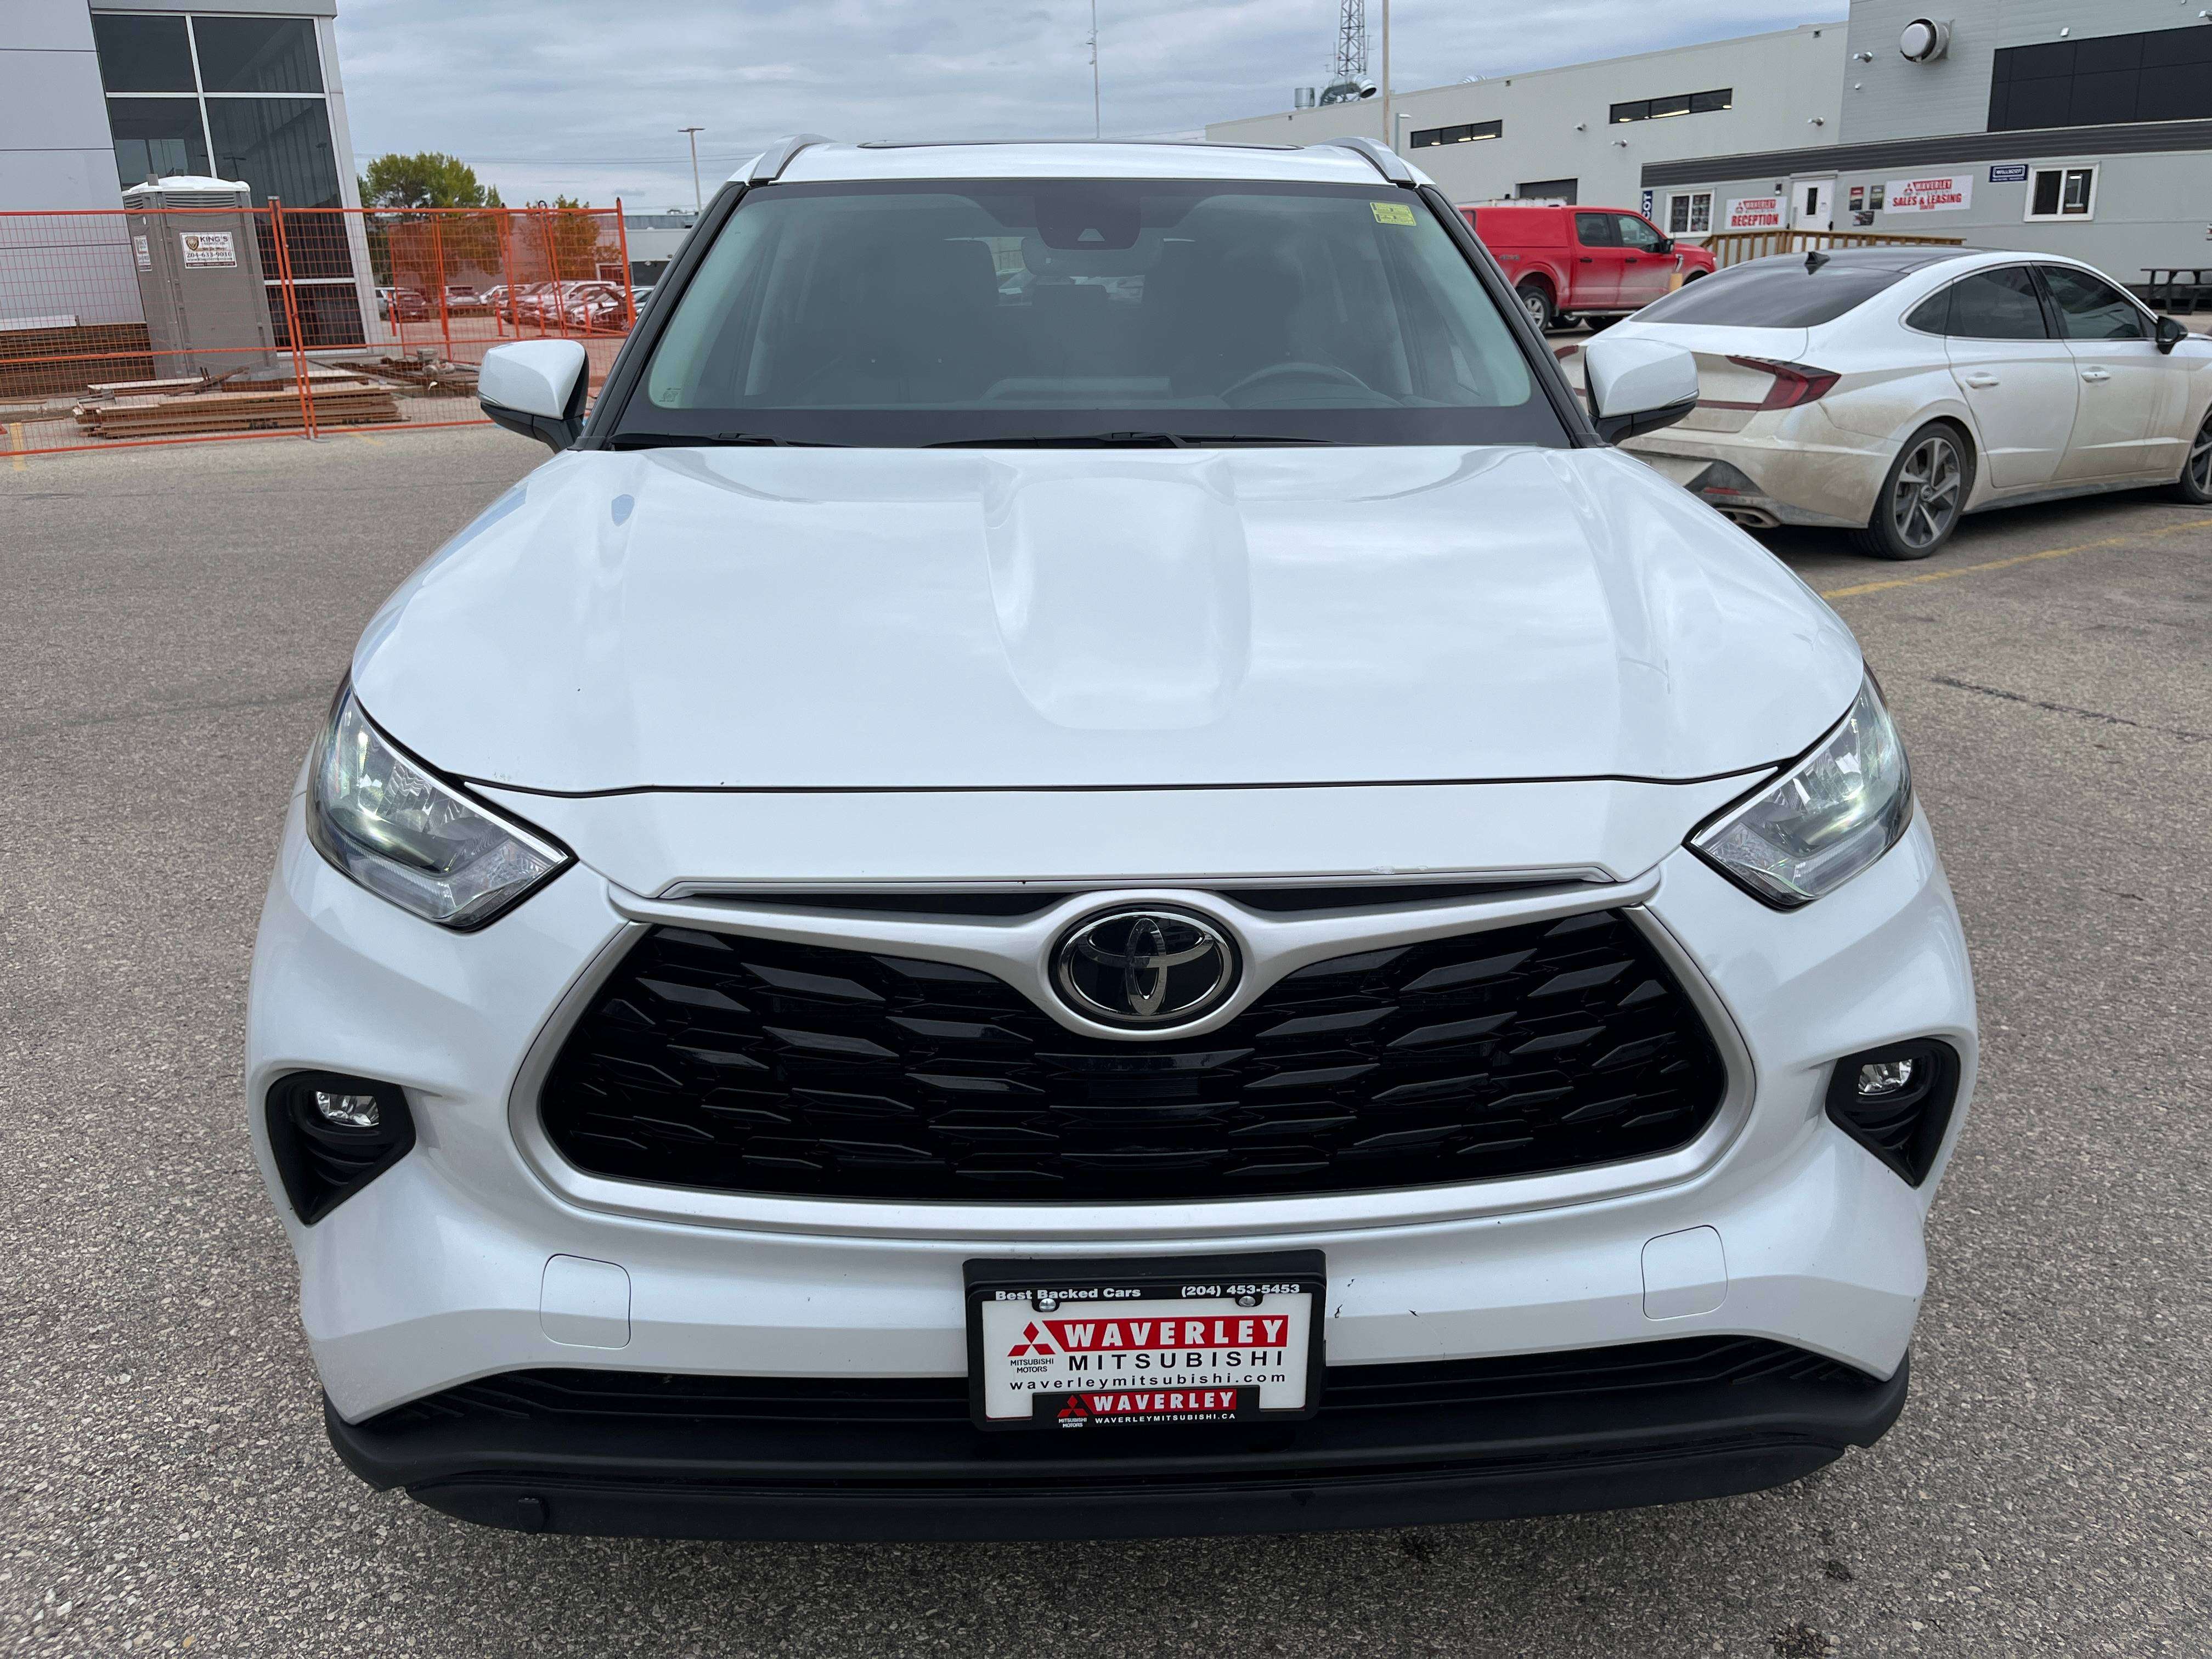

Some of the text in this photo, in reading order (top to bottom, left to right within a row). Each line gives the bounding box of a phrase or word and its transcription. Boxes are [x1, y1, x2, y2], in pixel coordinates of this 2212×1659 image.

[1893, 196, 1917, 206] SALES
[1927, 193, 1962, 206] LEASING
[1731, 214, 1779, 226] RECEPTION
[996, 1288, 1142, 1300] Best Backed Cars
[1181, 1284, 1300, 1297] (204) 453-5453
[1064, 1319, 1283, 1348] WAVERLEY
[1010, 1357, 1054, 1366] MITSUBISHI
[1069, 1351, 1282, 1371] MITSUBISHI
[1016, 1365, 1048, 1373] MOTORS
[1009, 1373, 1285, 1390] waverleymitsubishi.com
[1093, 1391, 1234, 1412] WAVERLEY
[1095, 1413, 1235, 1424] WAVERLEYMITSUBISHI.CA
